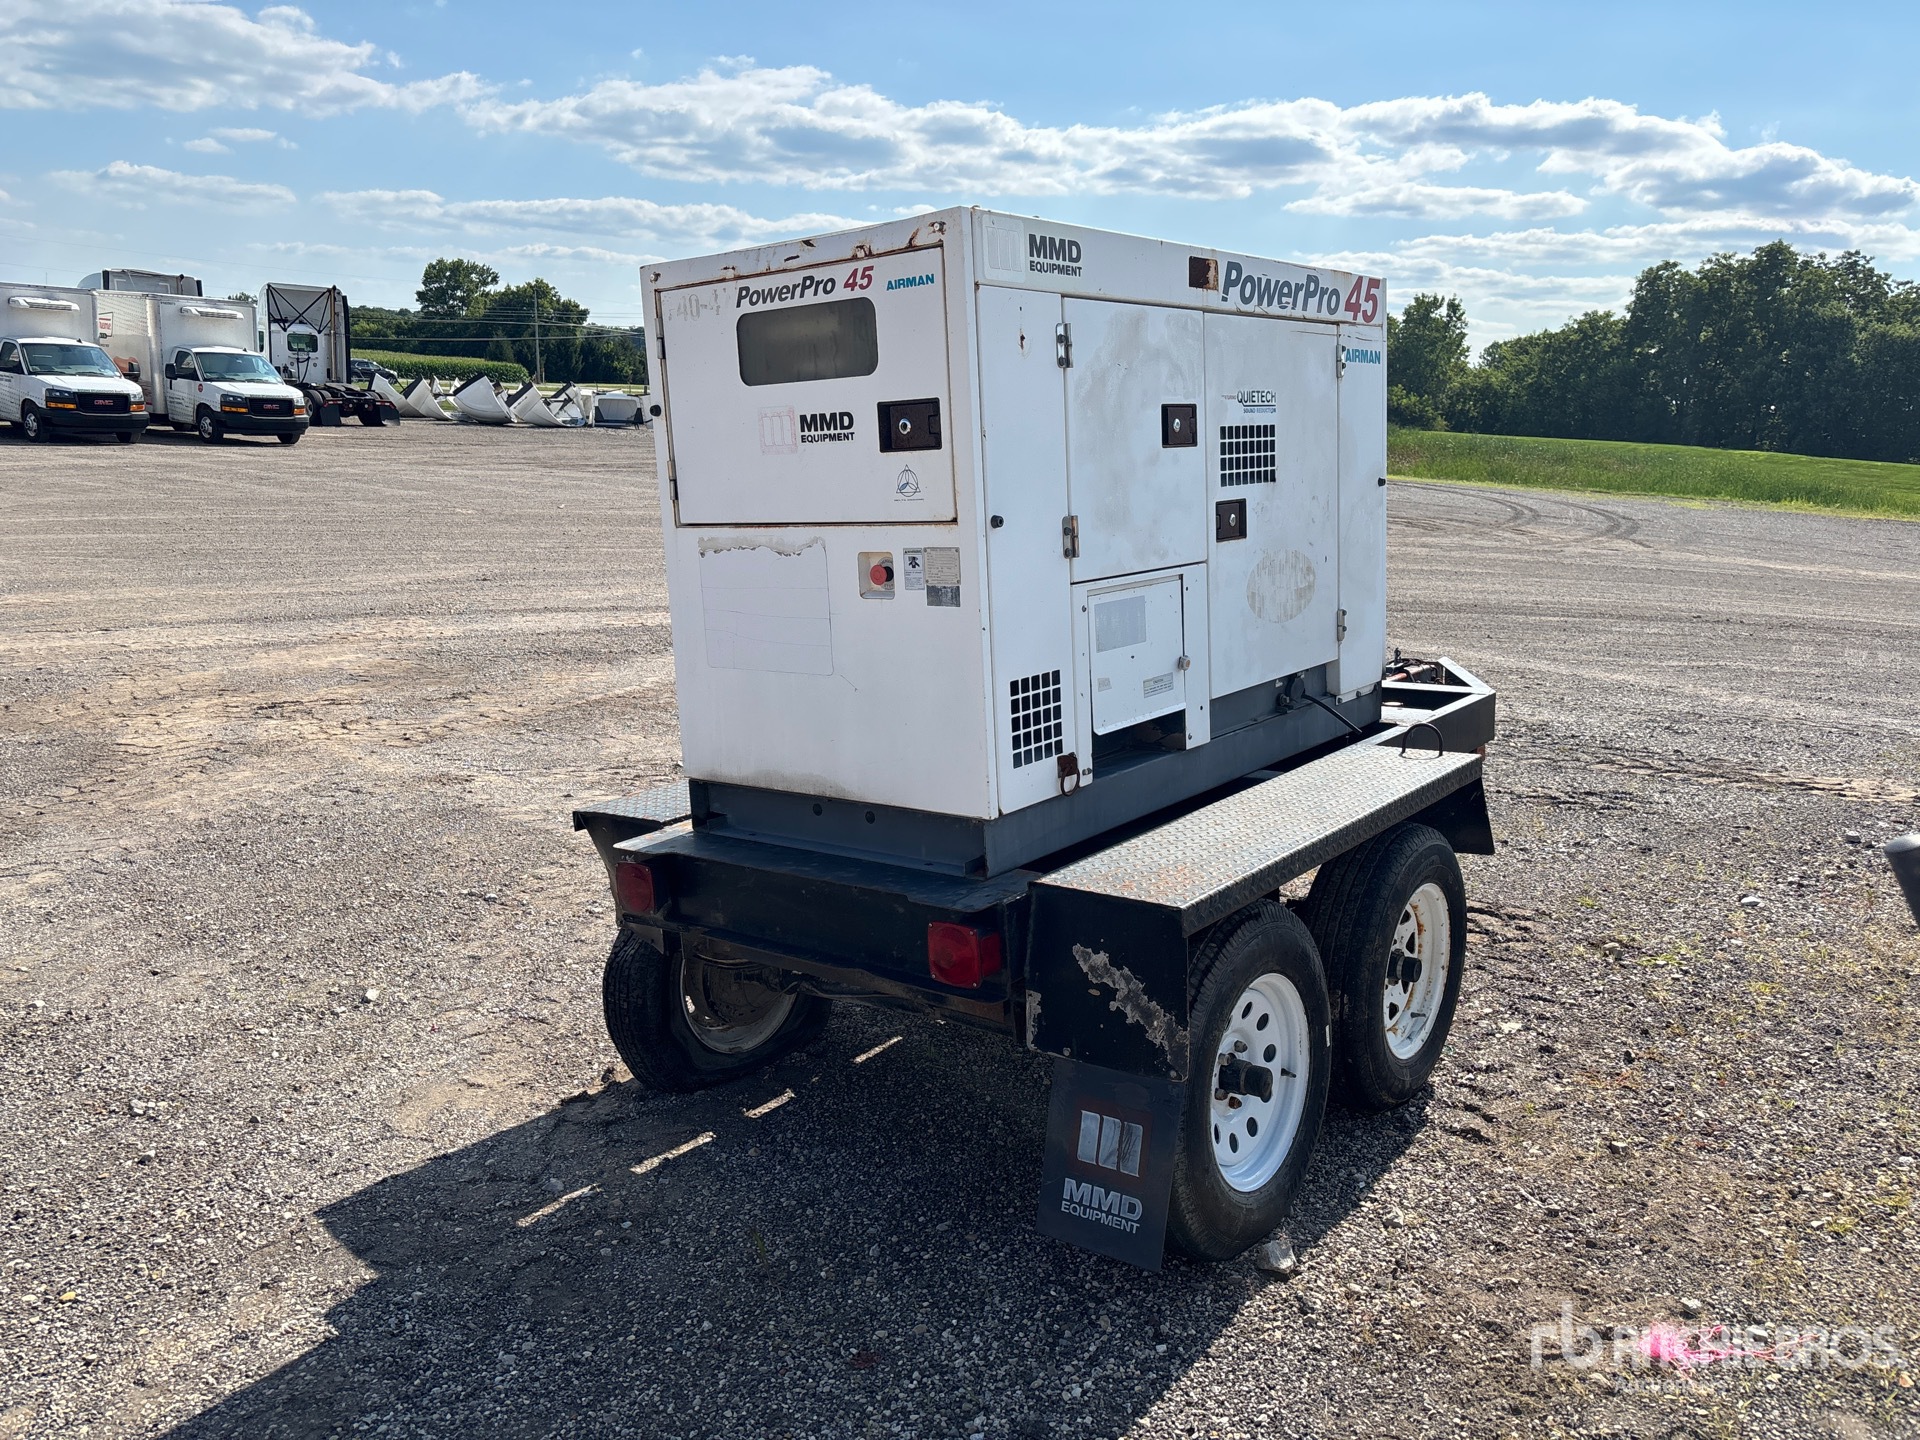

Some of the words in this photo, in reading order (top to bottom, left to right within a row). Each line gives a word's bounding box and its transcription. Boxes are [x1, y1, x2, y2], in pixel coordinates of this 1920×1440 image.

[1028, 233, 1081, 263] MMD
[1029, 260, 1082, 277] EQUIPMENT
[736, 275, 836, 308] PowerPro
[843, 265, 874, 291] 45
[886, 273, 935, 291] AIRMAN
[1221, 260, 1341, 316] PowerPro
[1344, 275, 1380, 323] 45
[1345, 348, 1381, 365] AIRMAN
[1236, 390, 1276, 404] QUIETECH
[800, 411, 854, 433] MMD
[800, 432, 855, 443] EQUIPMENT
[1063, 1178, 1143, 1220] MMD
[1061, 1202, 1140, 1234] EQUIPMENT
